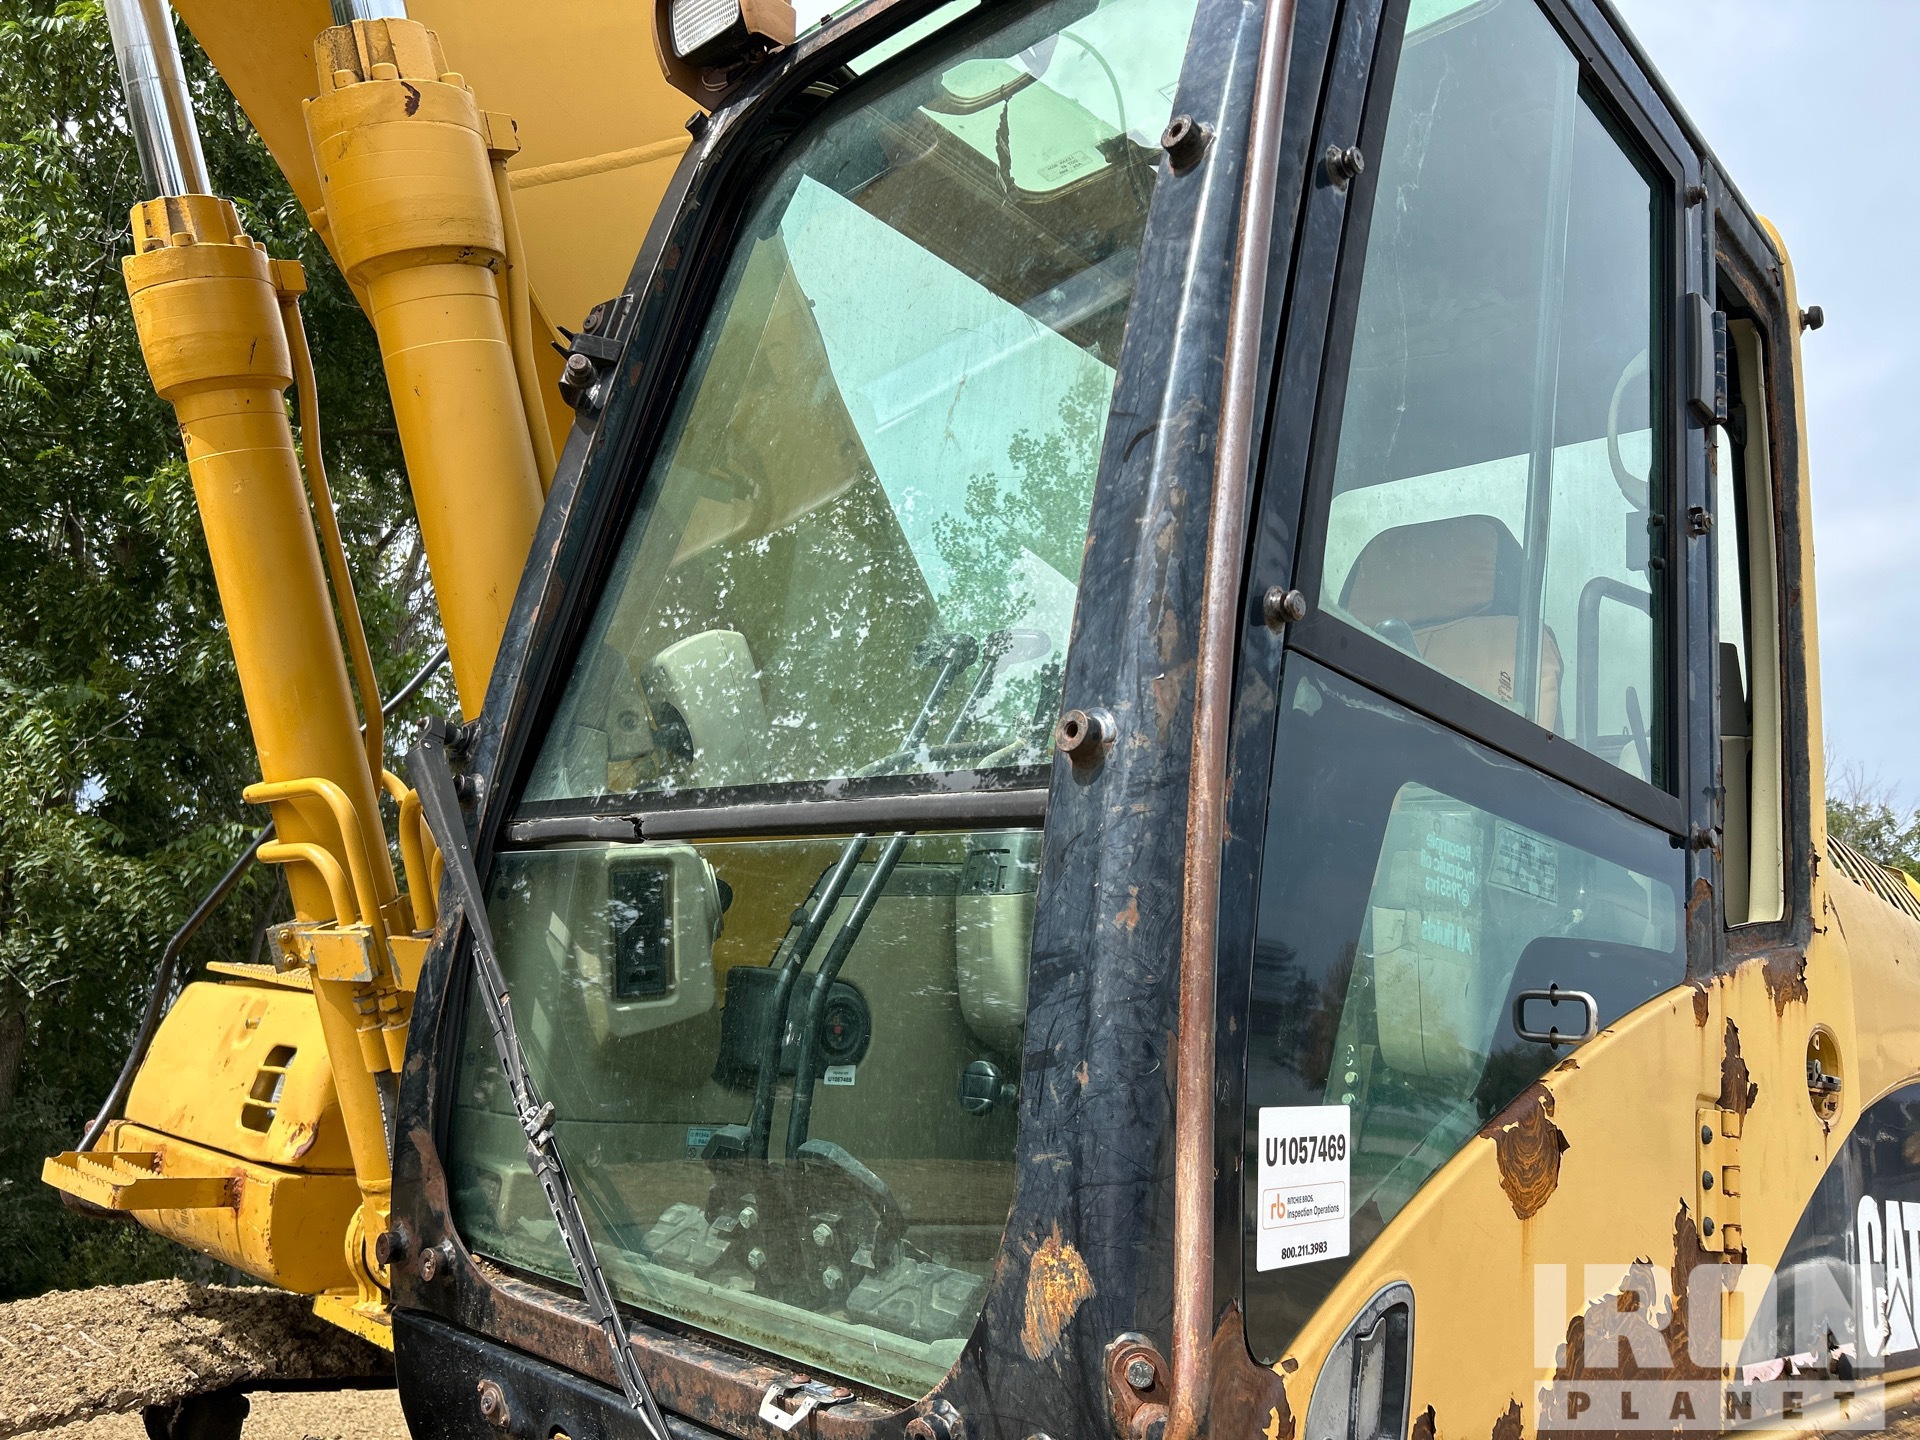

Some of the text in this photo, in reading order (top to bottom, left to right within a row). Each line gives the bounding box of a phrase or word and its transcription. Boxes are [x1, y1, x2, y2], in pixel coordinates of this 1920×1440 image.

[1265, 1134, 1346, 1167] U1057469
[1270, 1193, 1286, 1220] rb
[1287, 1195, 1302, 1205] RITCHIE
[1287, 1203, 1340, 1220] Inspection Operations
[1281, 1241, 1328, 1260] 800.211.3983
[1857, 1195, 1920, 1357] CAT
